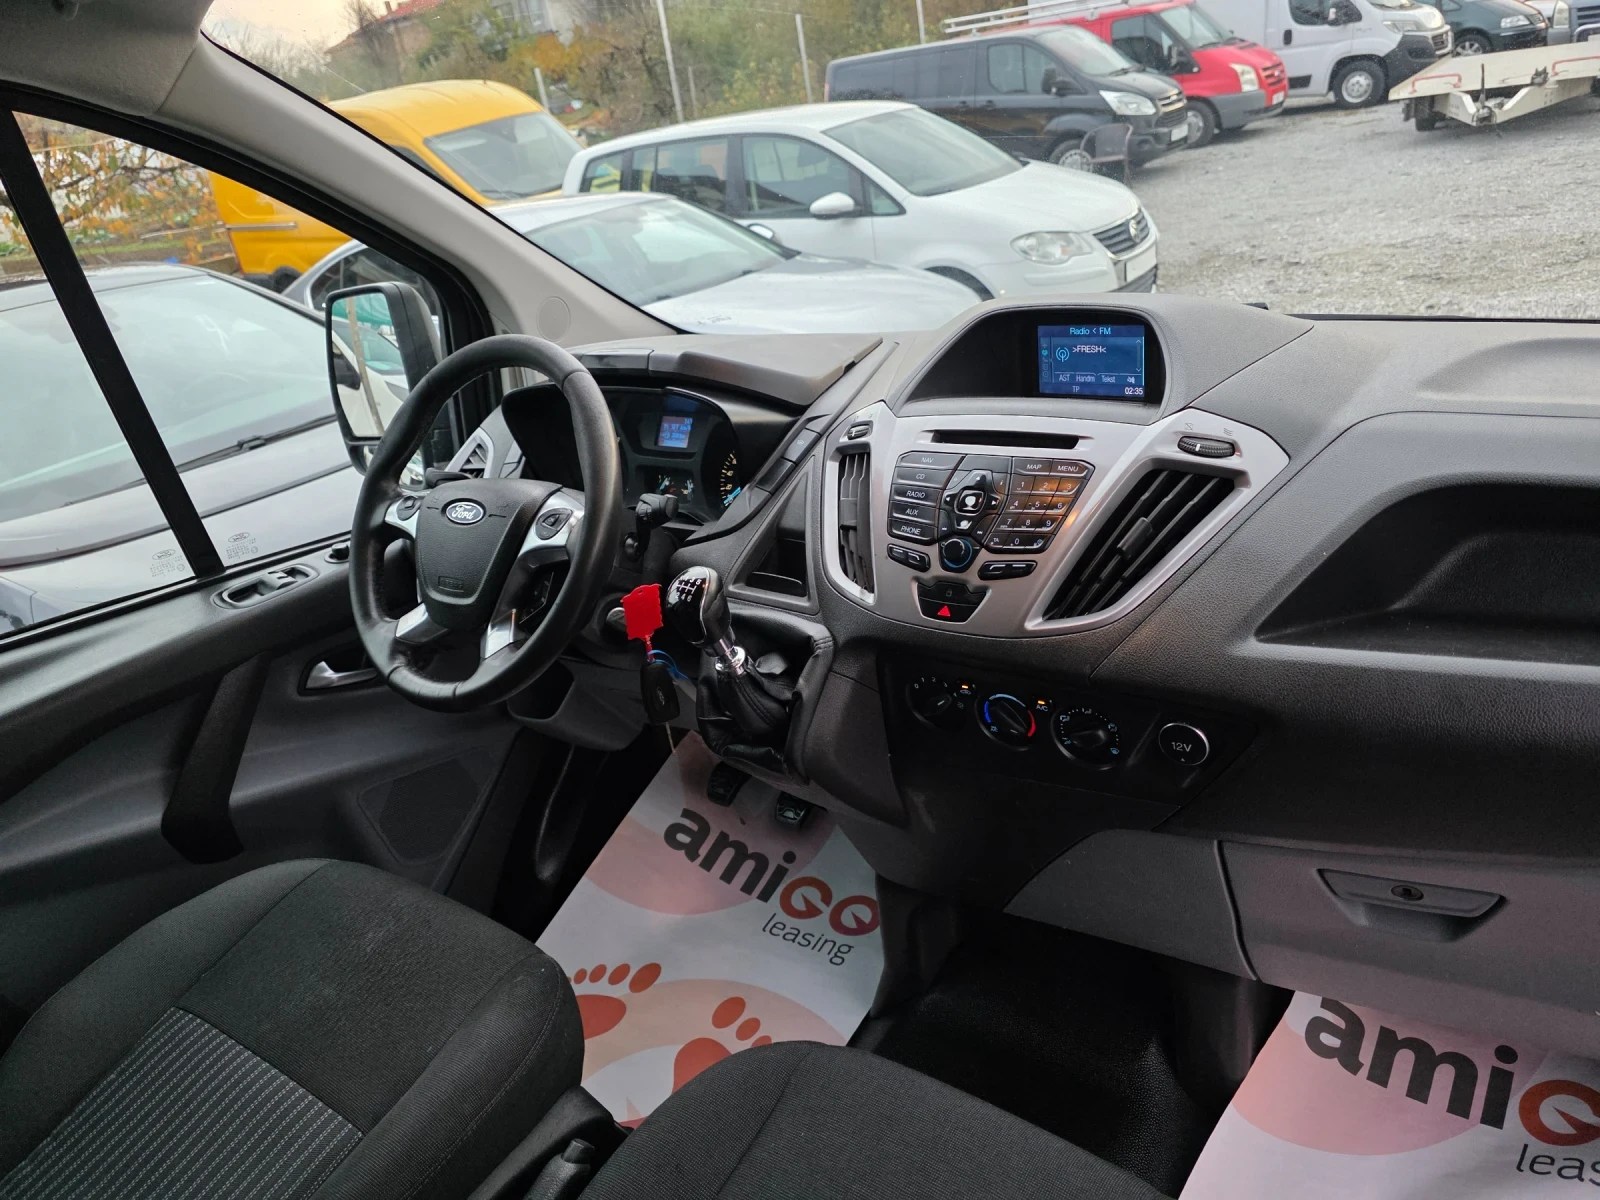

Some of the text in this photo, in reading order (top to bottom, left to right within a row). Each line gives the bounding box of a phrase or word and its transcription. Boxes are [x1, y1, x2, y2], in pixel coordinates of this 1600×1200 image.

[1070, 327, 1090, 335] Radio
[1099, 327, 1111, 335] FM
[1125, 387, 1143, 395] 02:35
[906, 490, 926, 499] RADIO
[451, 505, 475, 520] Ford
[905, 508, 919, 516] AUX
[900, 525, 921, 536] PHONE
[1036, 704, 1048, 712] A/C
[1171, 741, 1192, 752] 12V
[762, 912, 854, 966] leasing
